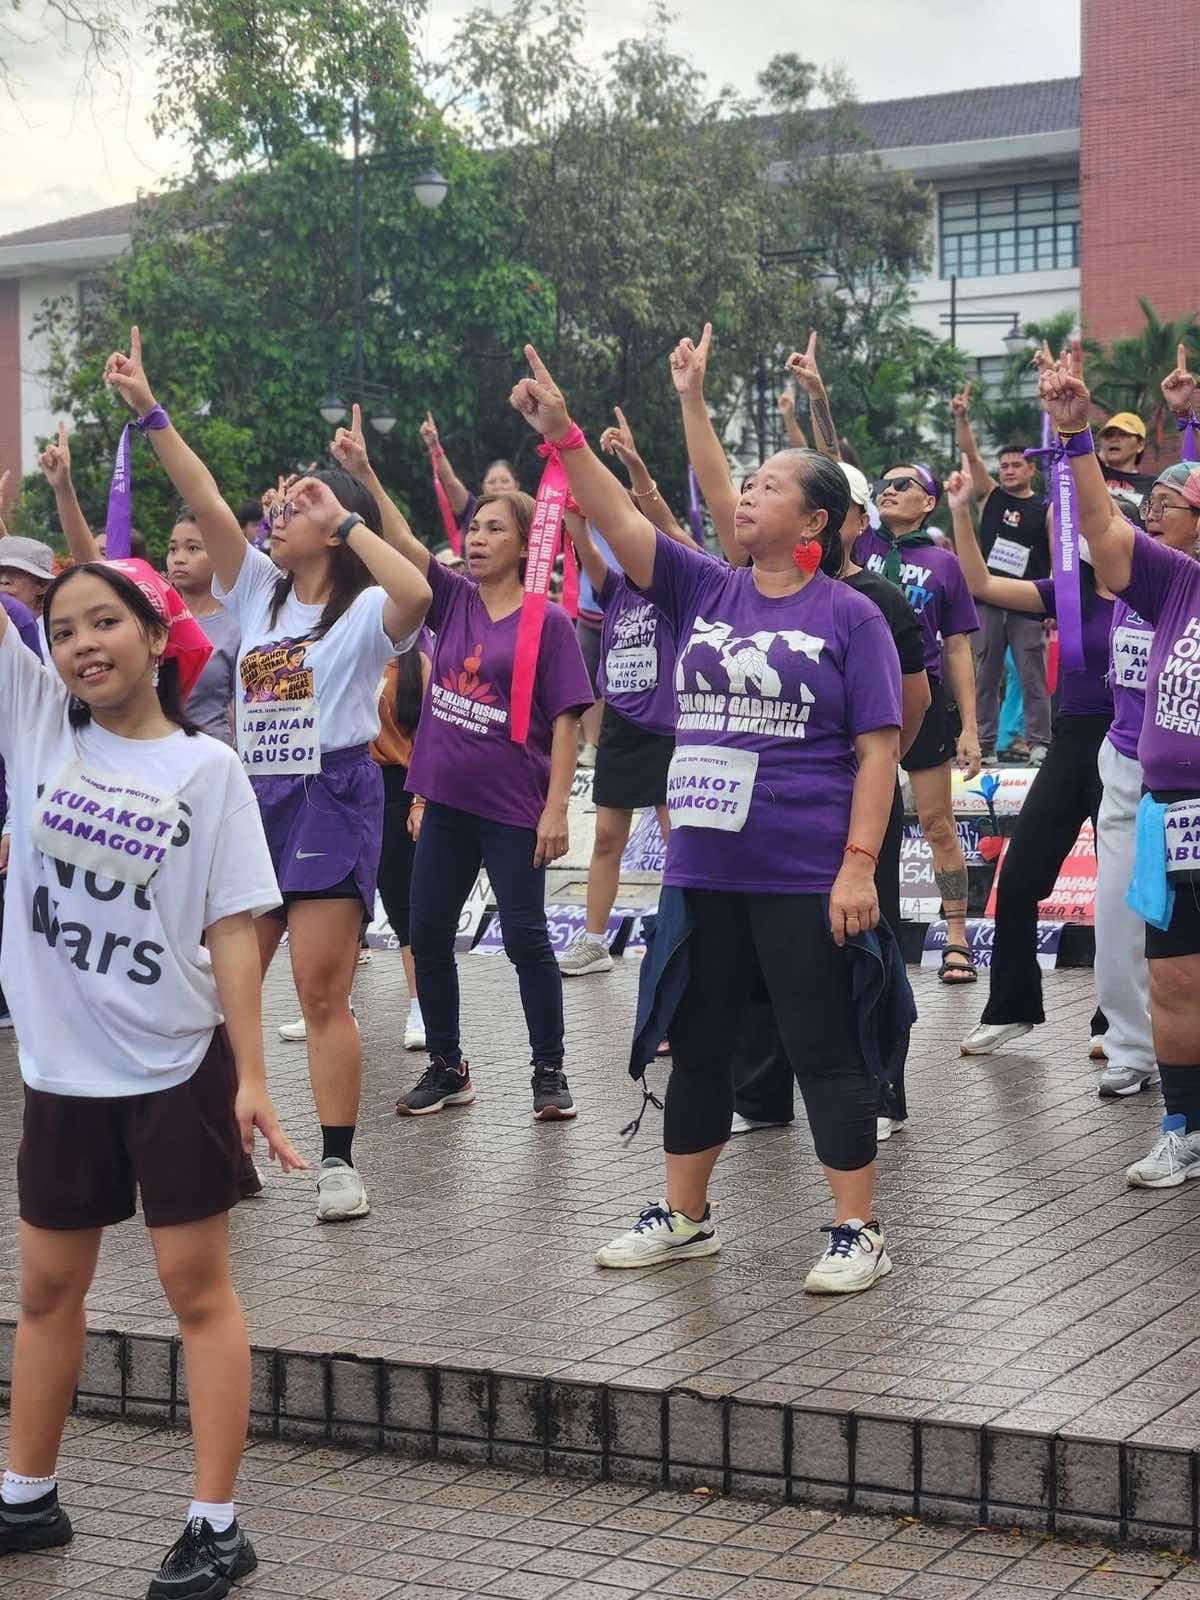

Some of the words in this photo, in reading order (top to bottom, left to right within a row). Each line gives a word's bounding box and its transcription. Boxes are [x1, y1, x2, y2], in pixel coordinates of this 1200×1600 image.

[534, 501, 547, 526] RAISE
[547, 503, 560, 522] ONE
[531, 528, 543, 545] THE
[540, 523, 557, 560] BILLION
[525, 546, 539, 593] VIBRATION
[534, 561, 549, 594] RISING
[617, 670, 638, 678] ANG
[471, 702, 507, 723] RISING
[728, 696, 810, 722] GABRIELA
[257, 733, 290, 746] ANG
[727, 716, 806, 739] MAKIBAKA
[241, 746, 315, 764] ABUSO!
[50, 788, 172, 838] KURAKOT
[42, 810, 167, 864] MANAGOT!
